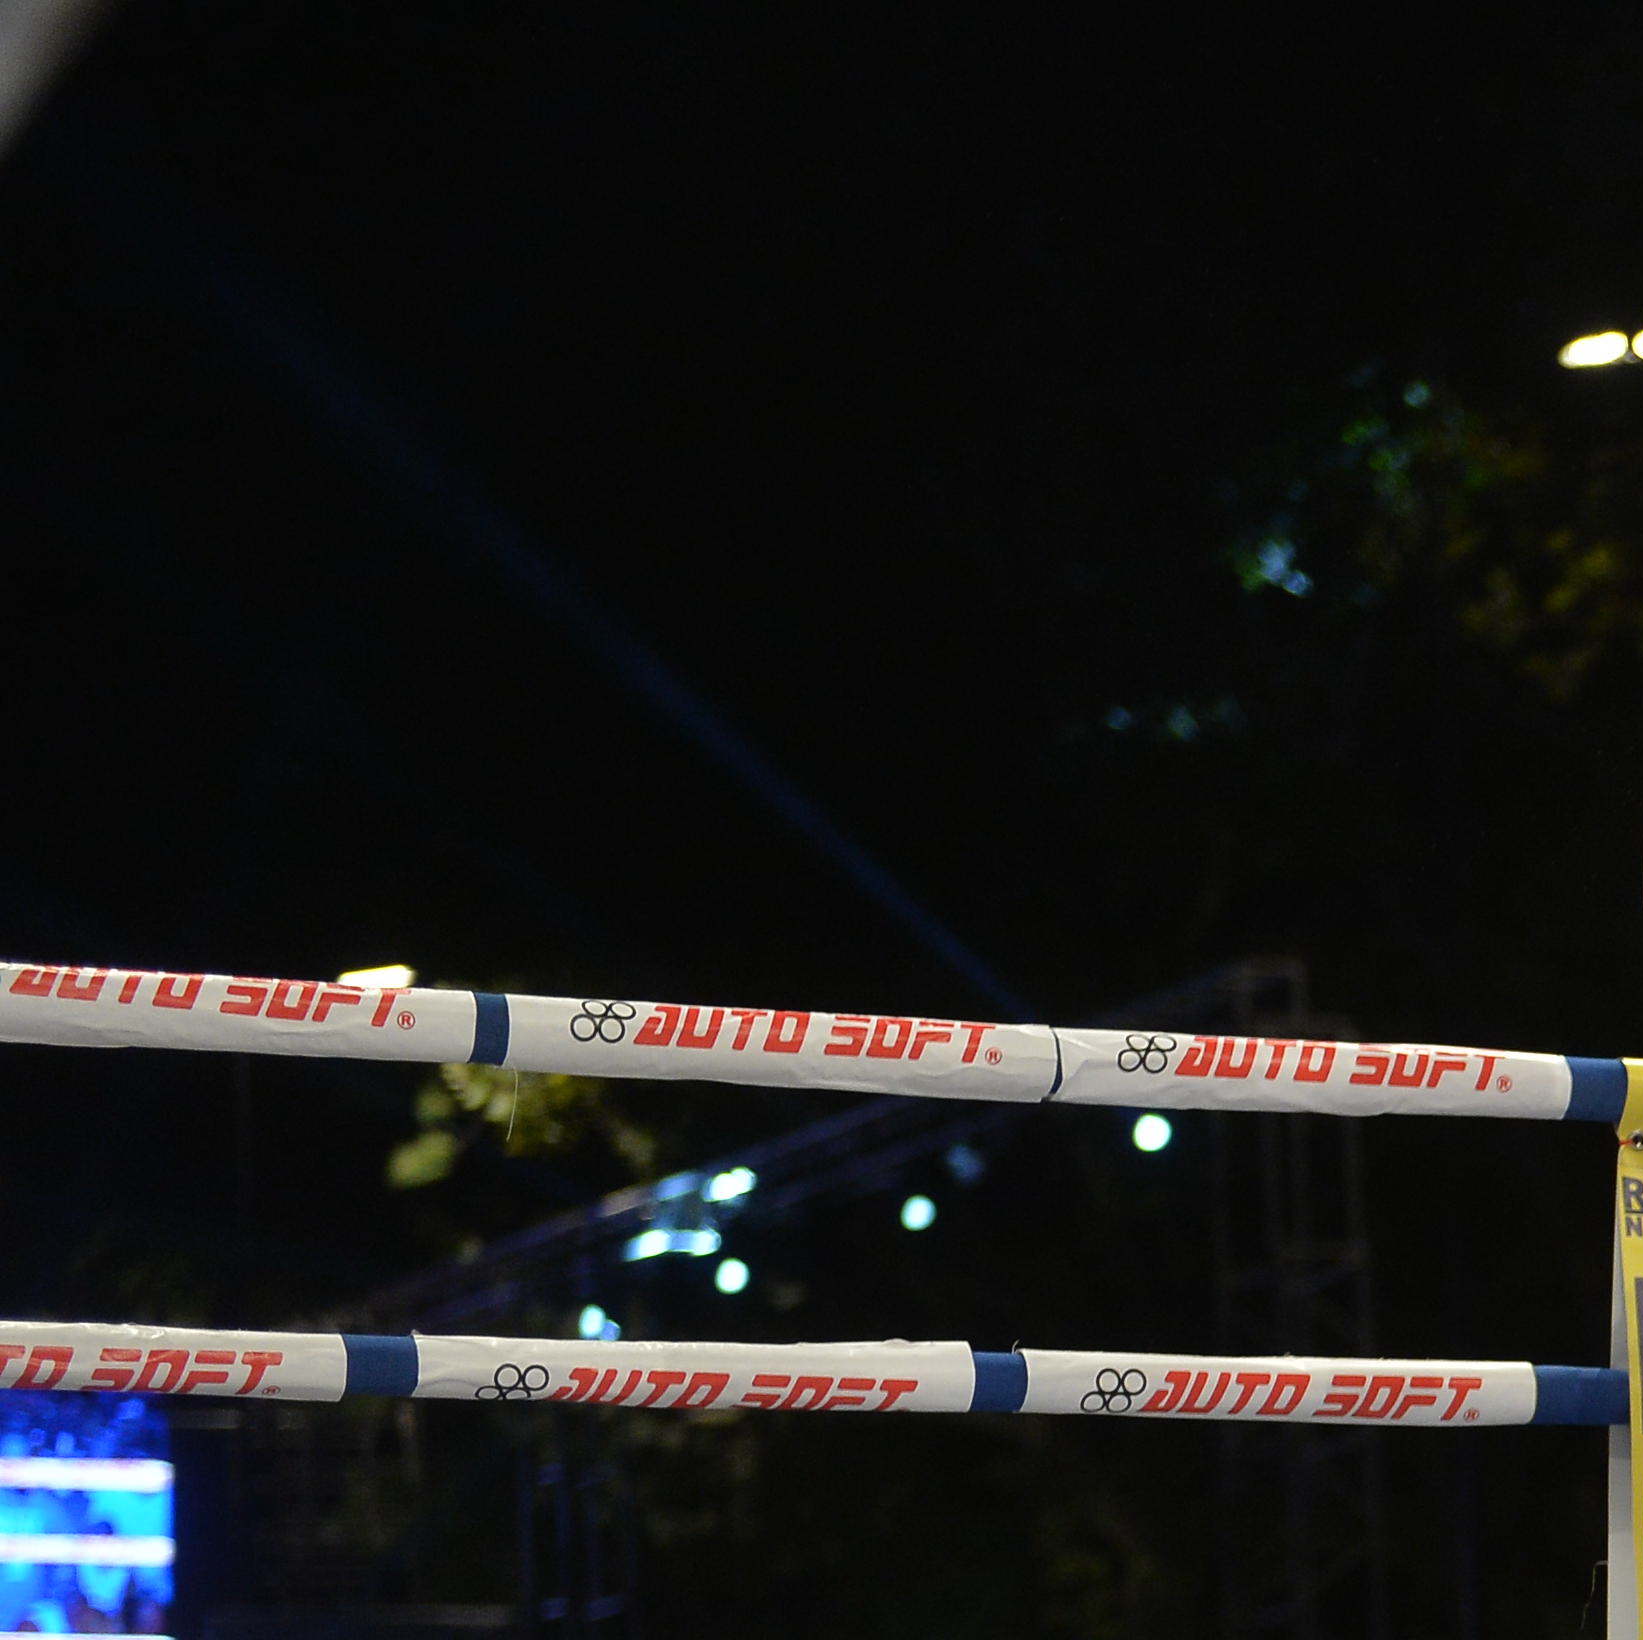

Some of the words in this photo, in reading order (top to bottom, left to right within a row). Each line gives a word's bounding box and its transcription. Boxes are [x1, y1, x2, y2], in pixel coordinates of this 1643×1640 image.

[219, 974, 408, 1028] SOFT
[633, 1004, 812, 1054] AUTO
[824, 1015, 996, 1064] SOFT
[1175, 1035, 1337, 1083] AUTO
[1349, 1045, 1500, 1091] SOFT
[80, 1347, 284, 1395] SOFT
[1142, 1370, 1312, 1415] AUTO
[1316, 1374, 1485, 1421] SOFT
